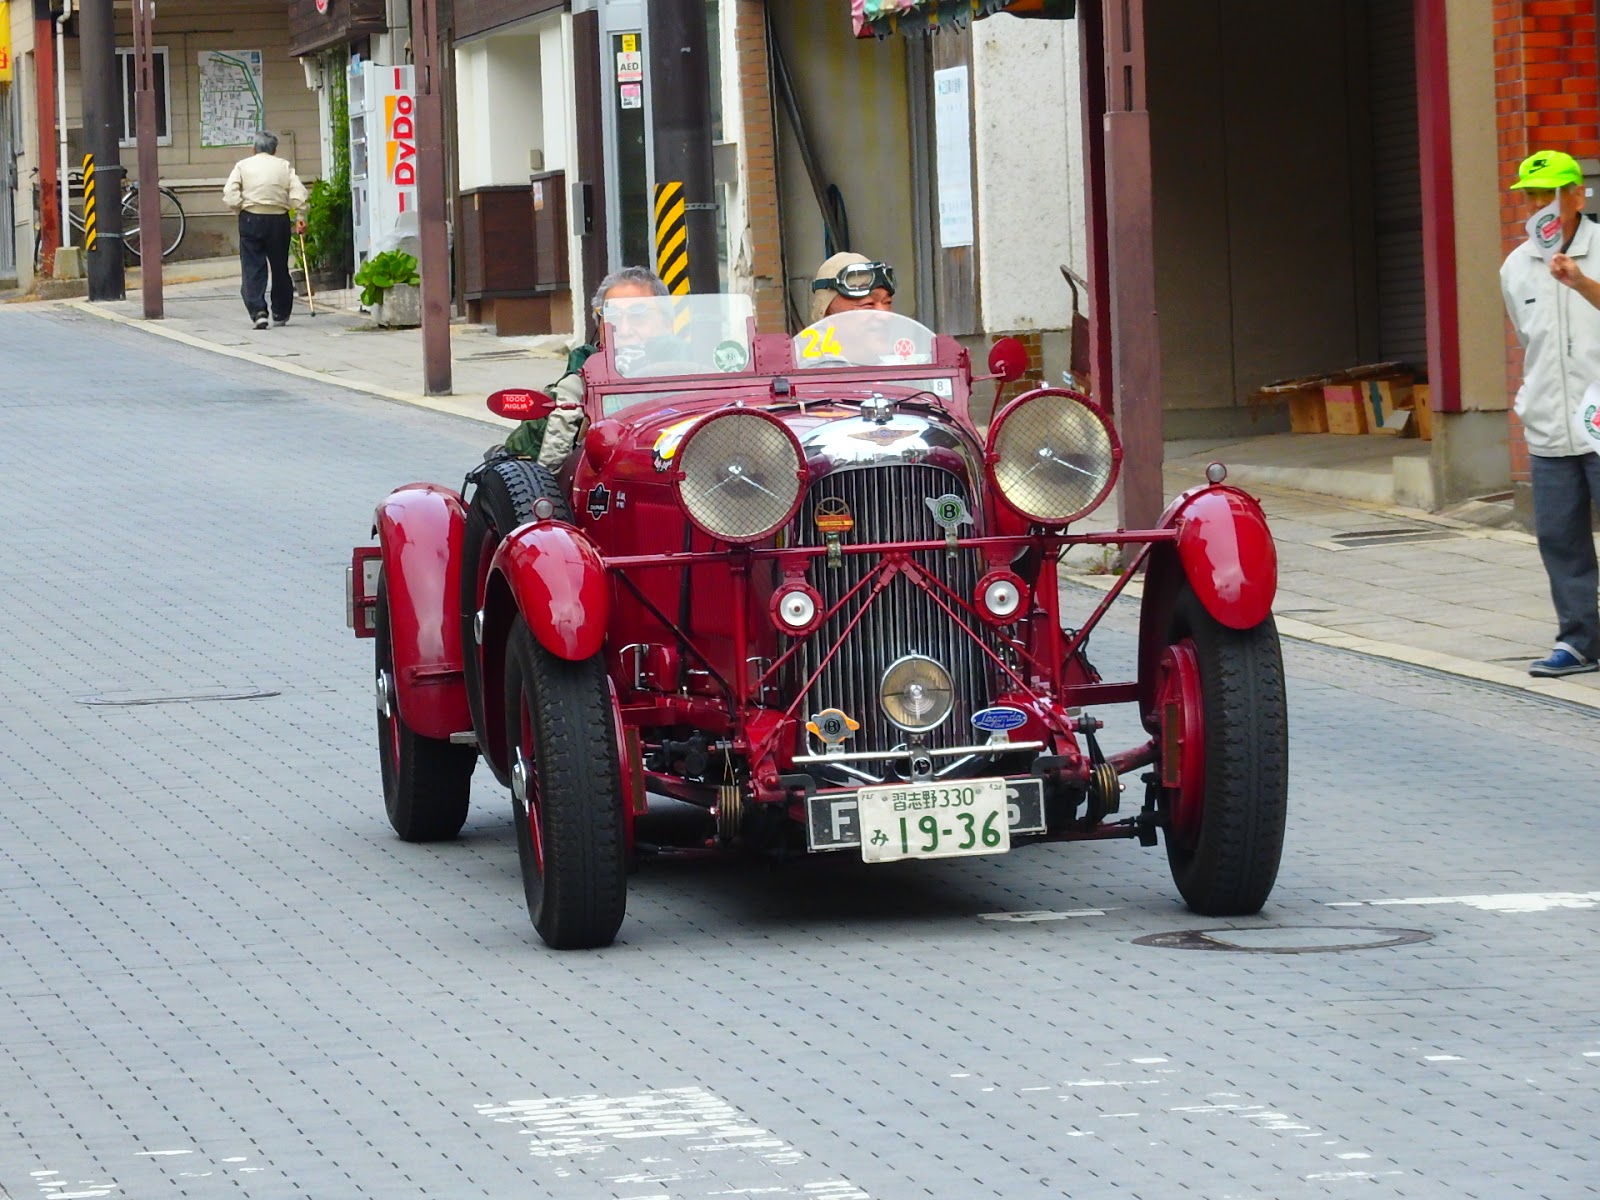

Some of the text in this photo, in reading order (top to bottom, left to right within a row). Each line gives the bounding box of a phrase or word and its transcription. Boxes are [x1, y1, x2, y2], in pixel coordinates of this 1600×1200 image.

[620, 62, 639, 71] AED
[393, 95, 416, 185] DyDo
[801, 325, 842, 358] 24
[831, 801, 857, 840] F
[870, 810, 1001, 854] み 19-36
